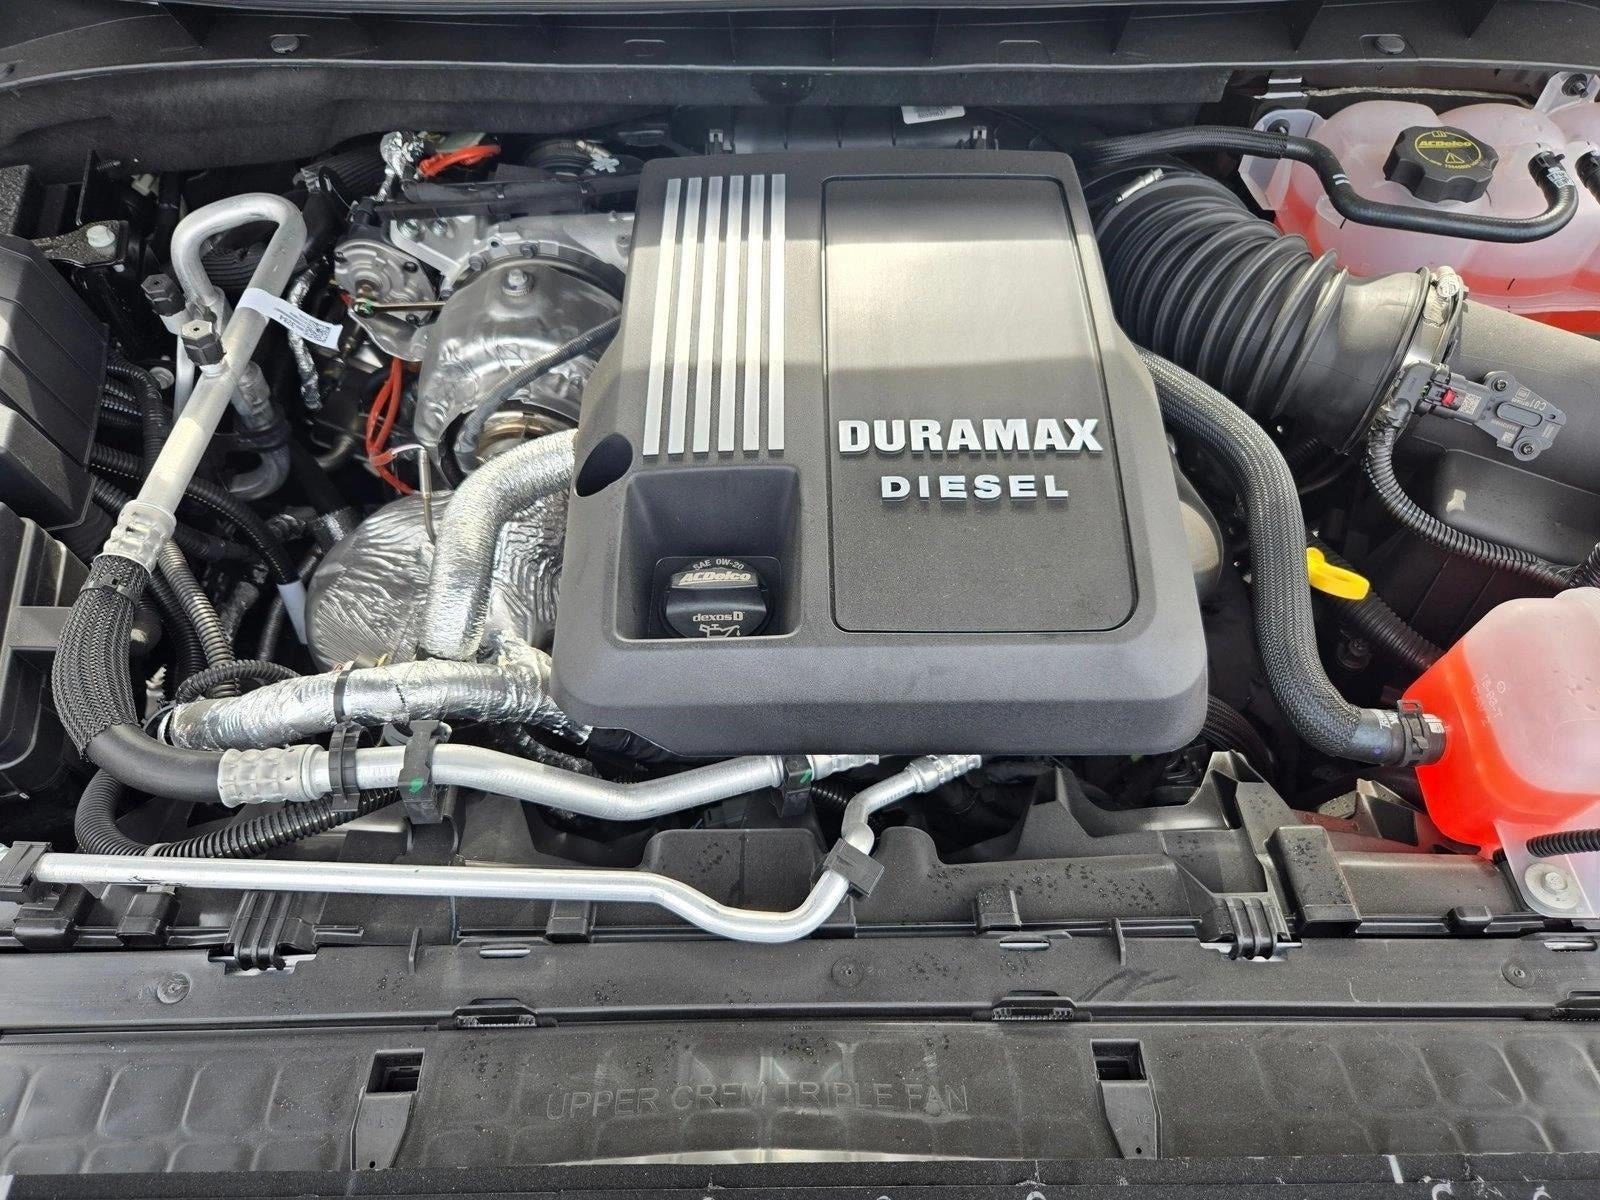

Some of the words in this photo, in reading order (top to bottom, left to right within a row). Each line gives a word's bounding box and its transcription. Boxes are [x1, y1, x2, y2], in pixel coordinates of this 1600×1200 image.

[838, 418, 1103, 453] DURAMAX
[881, 474, 1069, 500] DIESEL
[678, 570, 752, 584] ACDelco
[692, 559, 712, 571] SAE
[715, 558, 745, 570] 0W-20
[546, 1087, 660, 1120] UPPER
[777, 1081, 895, 1112] TRIPLE
[904, 1081, 968, 1114] FAN
